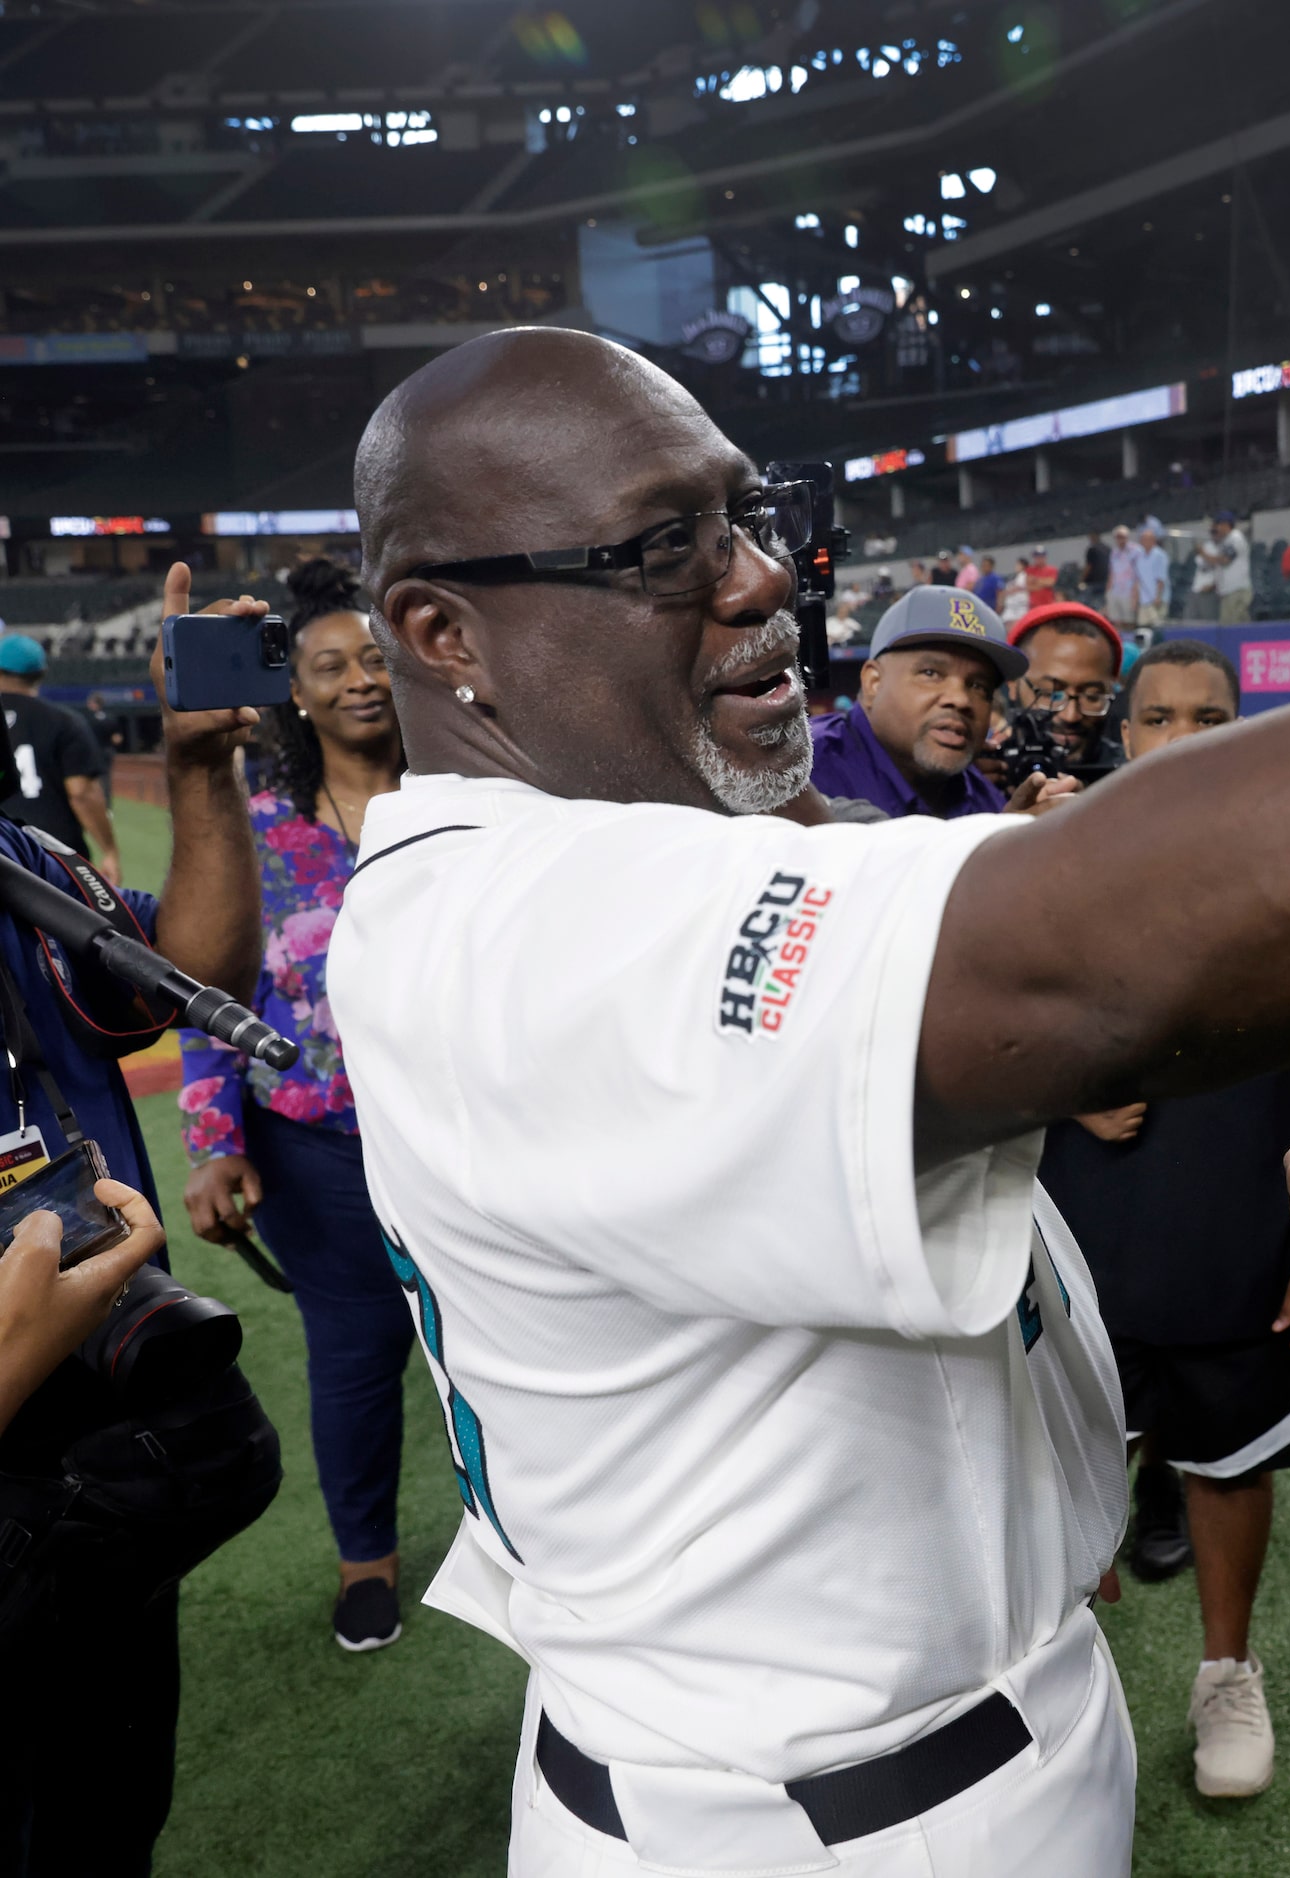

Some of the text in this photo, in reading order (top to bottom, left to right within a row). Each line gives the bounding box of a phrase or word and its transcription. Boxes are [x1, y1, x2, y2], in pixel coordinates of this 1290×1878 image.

[75, 865, 116, 912] Canon
[719, 871, 806, 1034] HBCU
[760, 886, 833, 1033] CLASSIC
